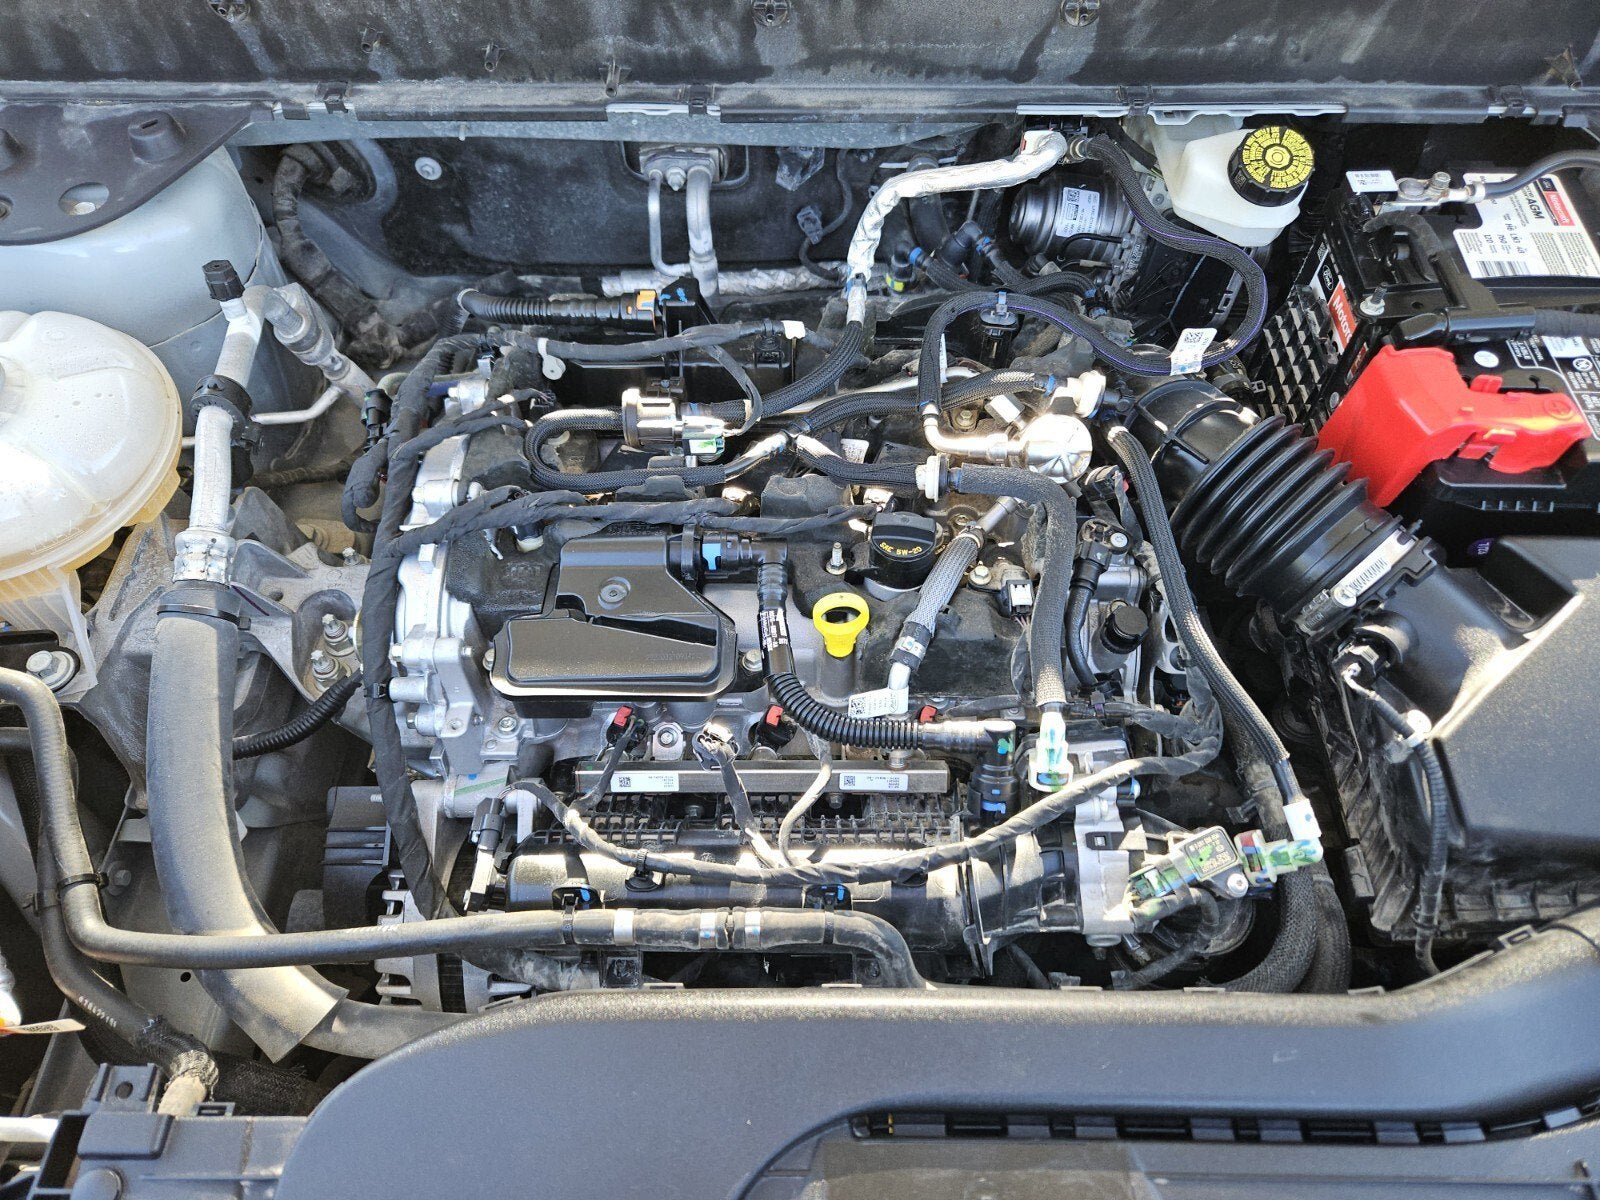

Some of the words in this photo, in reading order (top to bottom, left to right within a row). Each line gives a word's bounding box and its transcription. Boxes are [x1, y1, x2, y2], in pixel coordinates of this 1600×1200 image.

[1526, 198, 1545, 219] AGM
[879, 541, 894, 553] SAE
[895, 546, 923, 556] 5W-20
